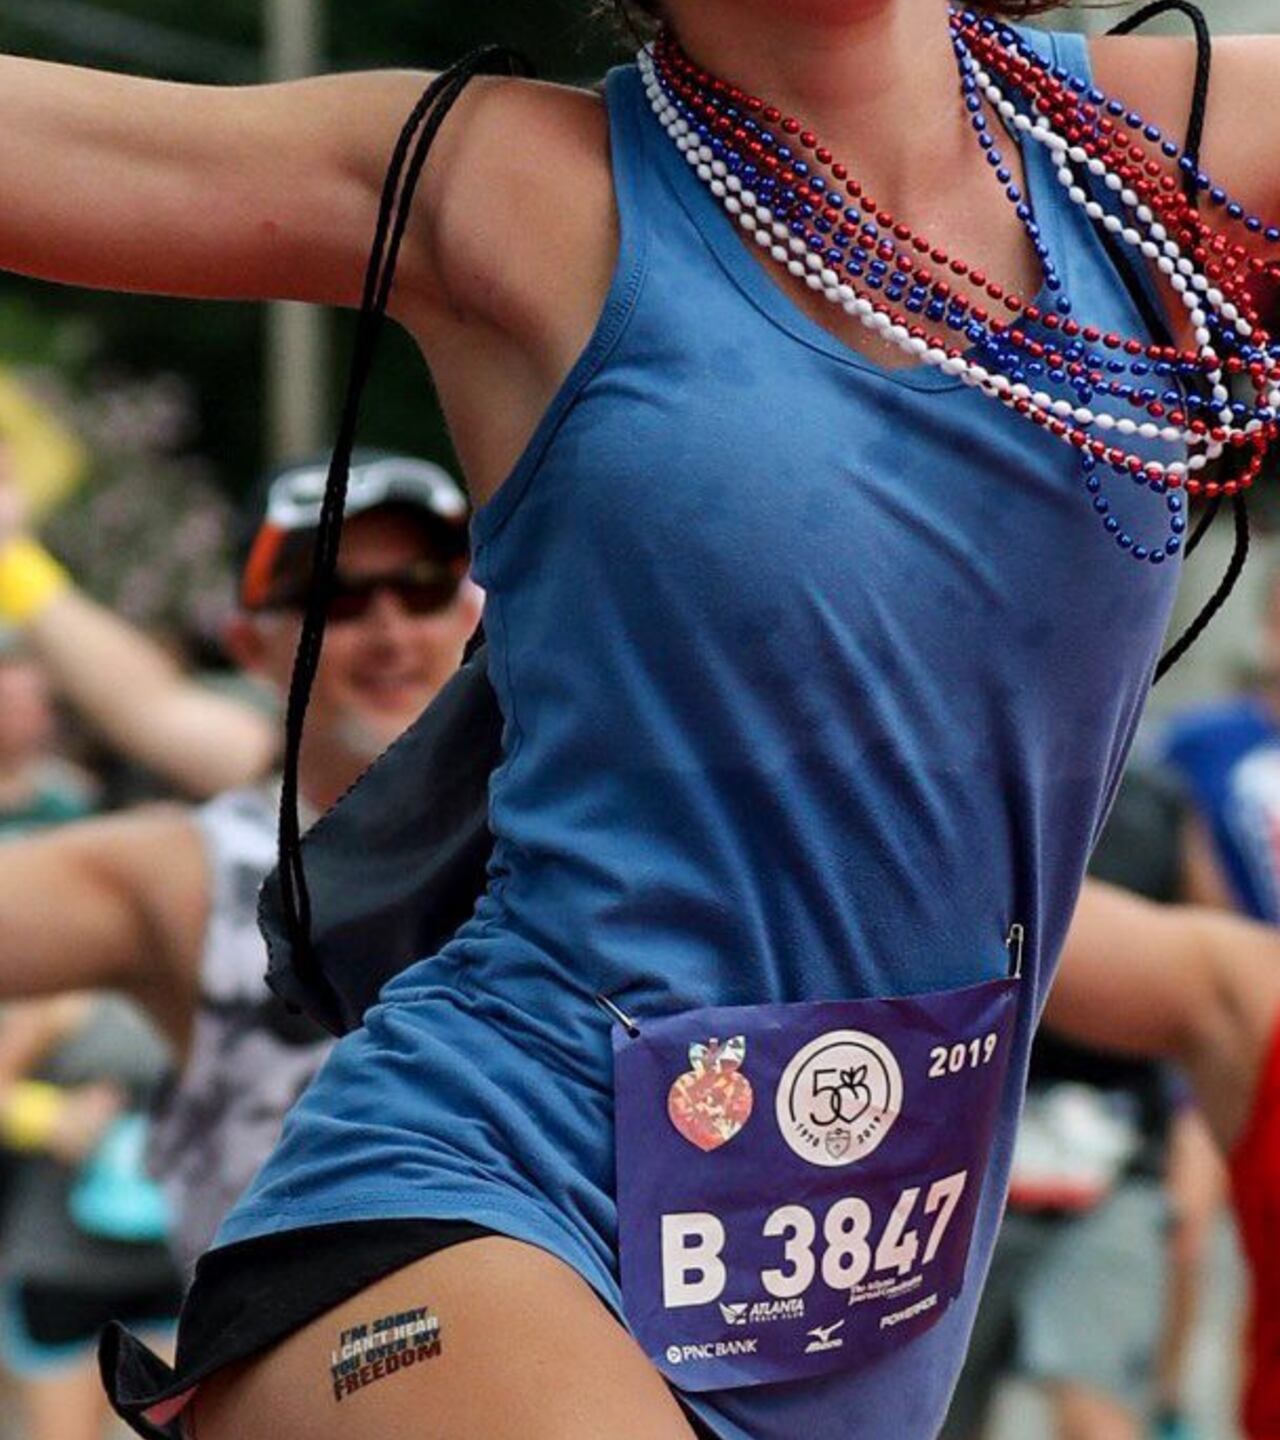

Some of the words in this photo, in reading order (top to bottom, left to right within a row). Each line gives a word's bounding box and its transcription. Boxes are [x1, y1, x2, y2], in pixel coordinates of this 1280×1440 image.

[928, 1032, 998, 1078] 2019
[661, 1212, 727, 1308] B
[761, 1170, 968, 1298] 3847
[333, 1340, 442, 1402] FREEDOM
[682, 1343, 715, 1360] PNC
[715, 1339, 758, 1357] BANK
